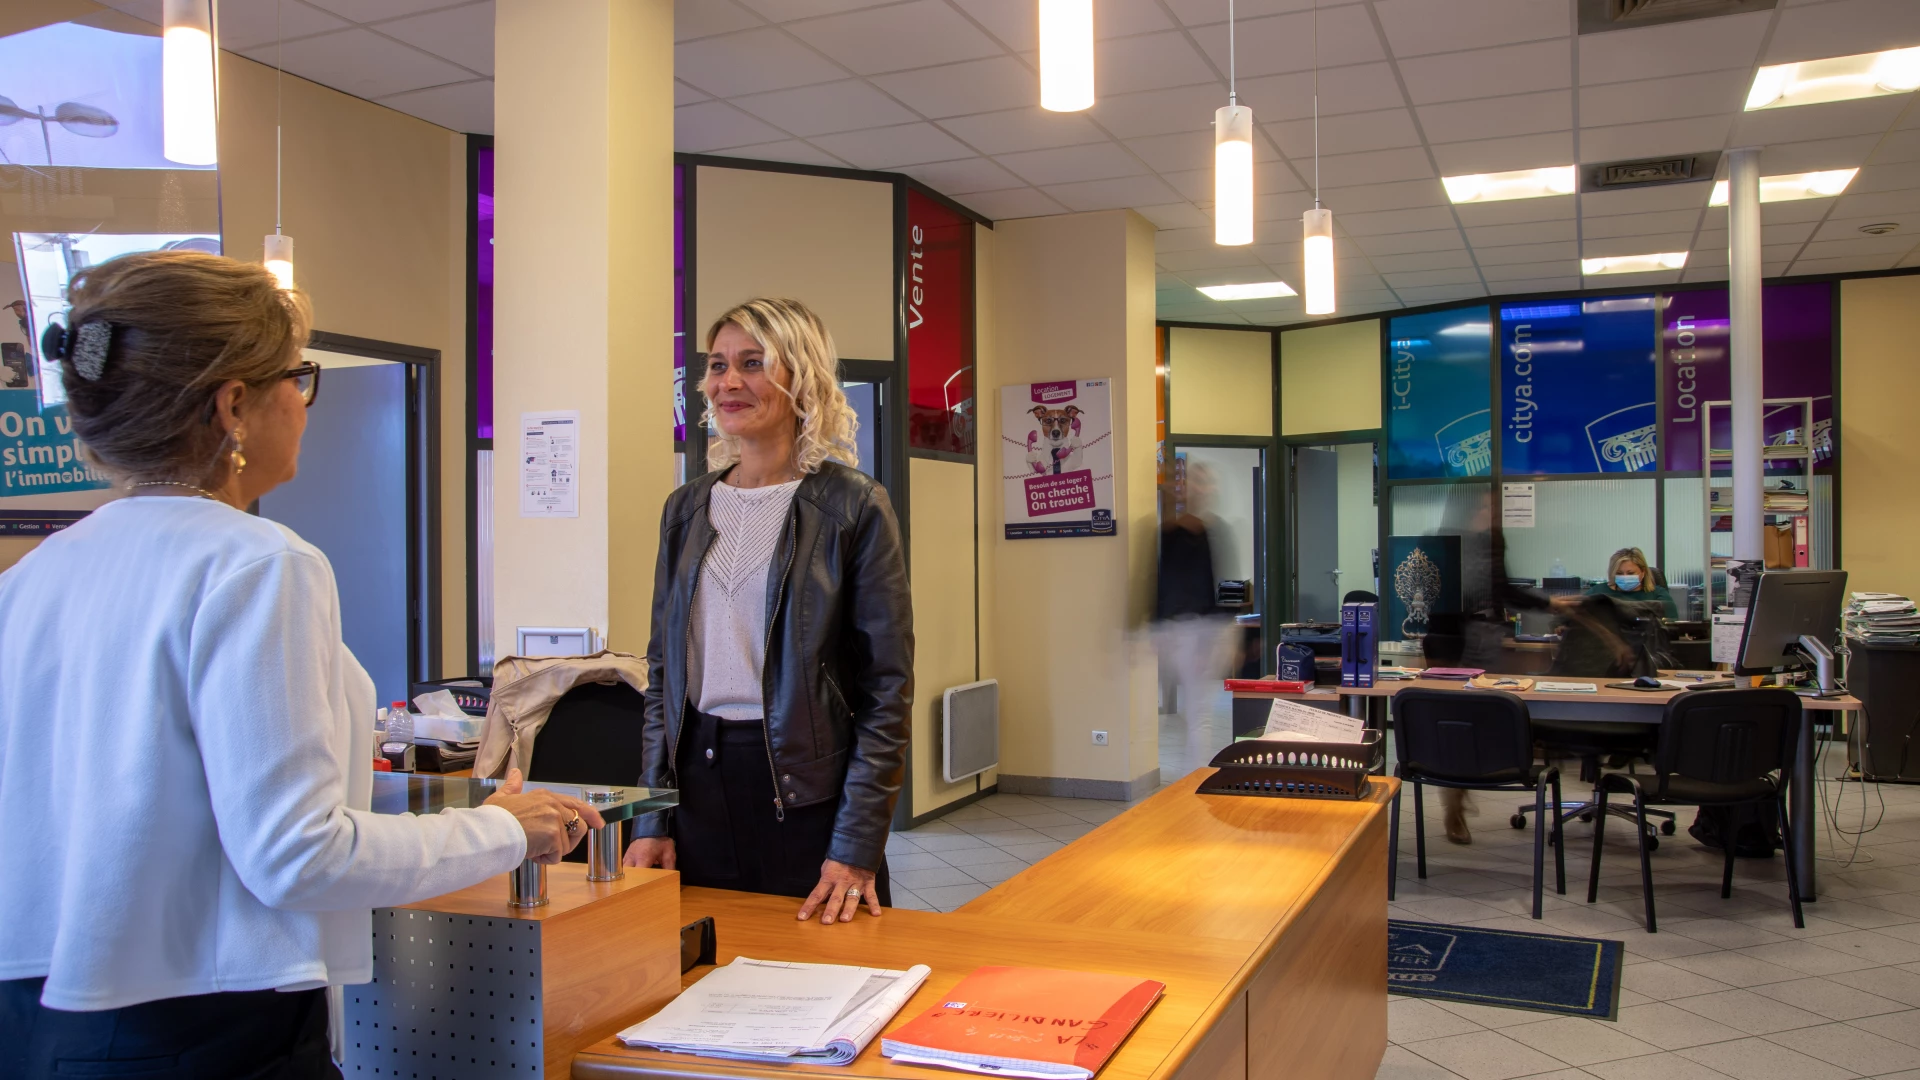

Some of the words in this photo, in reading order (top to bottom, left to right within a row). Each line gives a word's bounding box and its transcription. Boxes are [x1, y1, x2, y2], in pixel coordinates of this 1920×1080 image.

[909, 225, 924, 329] Vente
[1392, 337, 1415, 411] i-Citya
[1671, 315, 1696, 423] Location
[1033, 385, 1059, 395] Location
[1043, 390, 1071, 400] LOGEMENT
[1508, 324, 1538, 443] citya.com
[0, 411, 46, 437] On
[54, 416, 72, 435] v
[3, 438, 83, 469] simpl
[1029, 482, 1050, 490] Besoin
[1030, 491, 1046, 500] On
[1048, 484, 1089, 498] cherche
[1031, 501, 1047, 511] On
[1049, 496, 1084, 508] trouve
[1086, 493, 1091, 503] !
